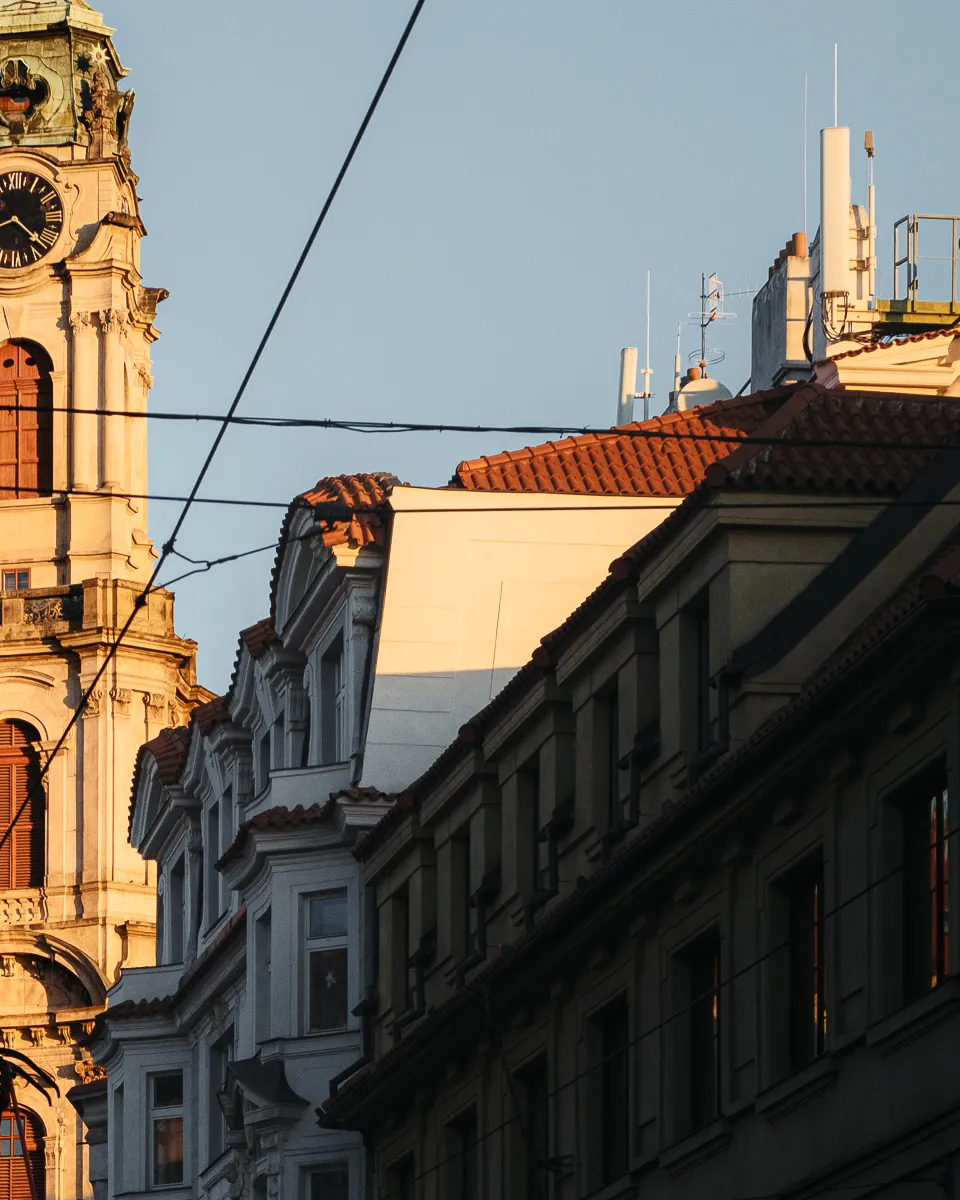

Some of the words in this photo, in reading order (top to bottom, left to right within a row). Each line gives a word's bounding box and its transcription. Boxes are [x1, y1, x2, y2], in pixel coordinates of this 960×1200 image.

[8, 172, 23, 191] XII
[40, 190, 57, 205] II
[45, 209, 63, 223] III
